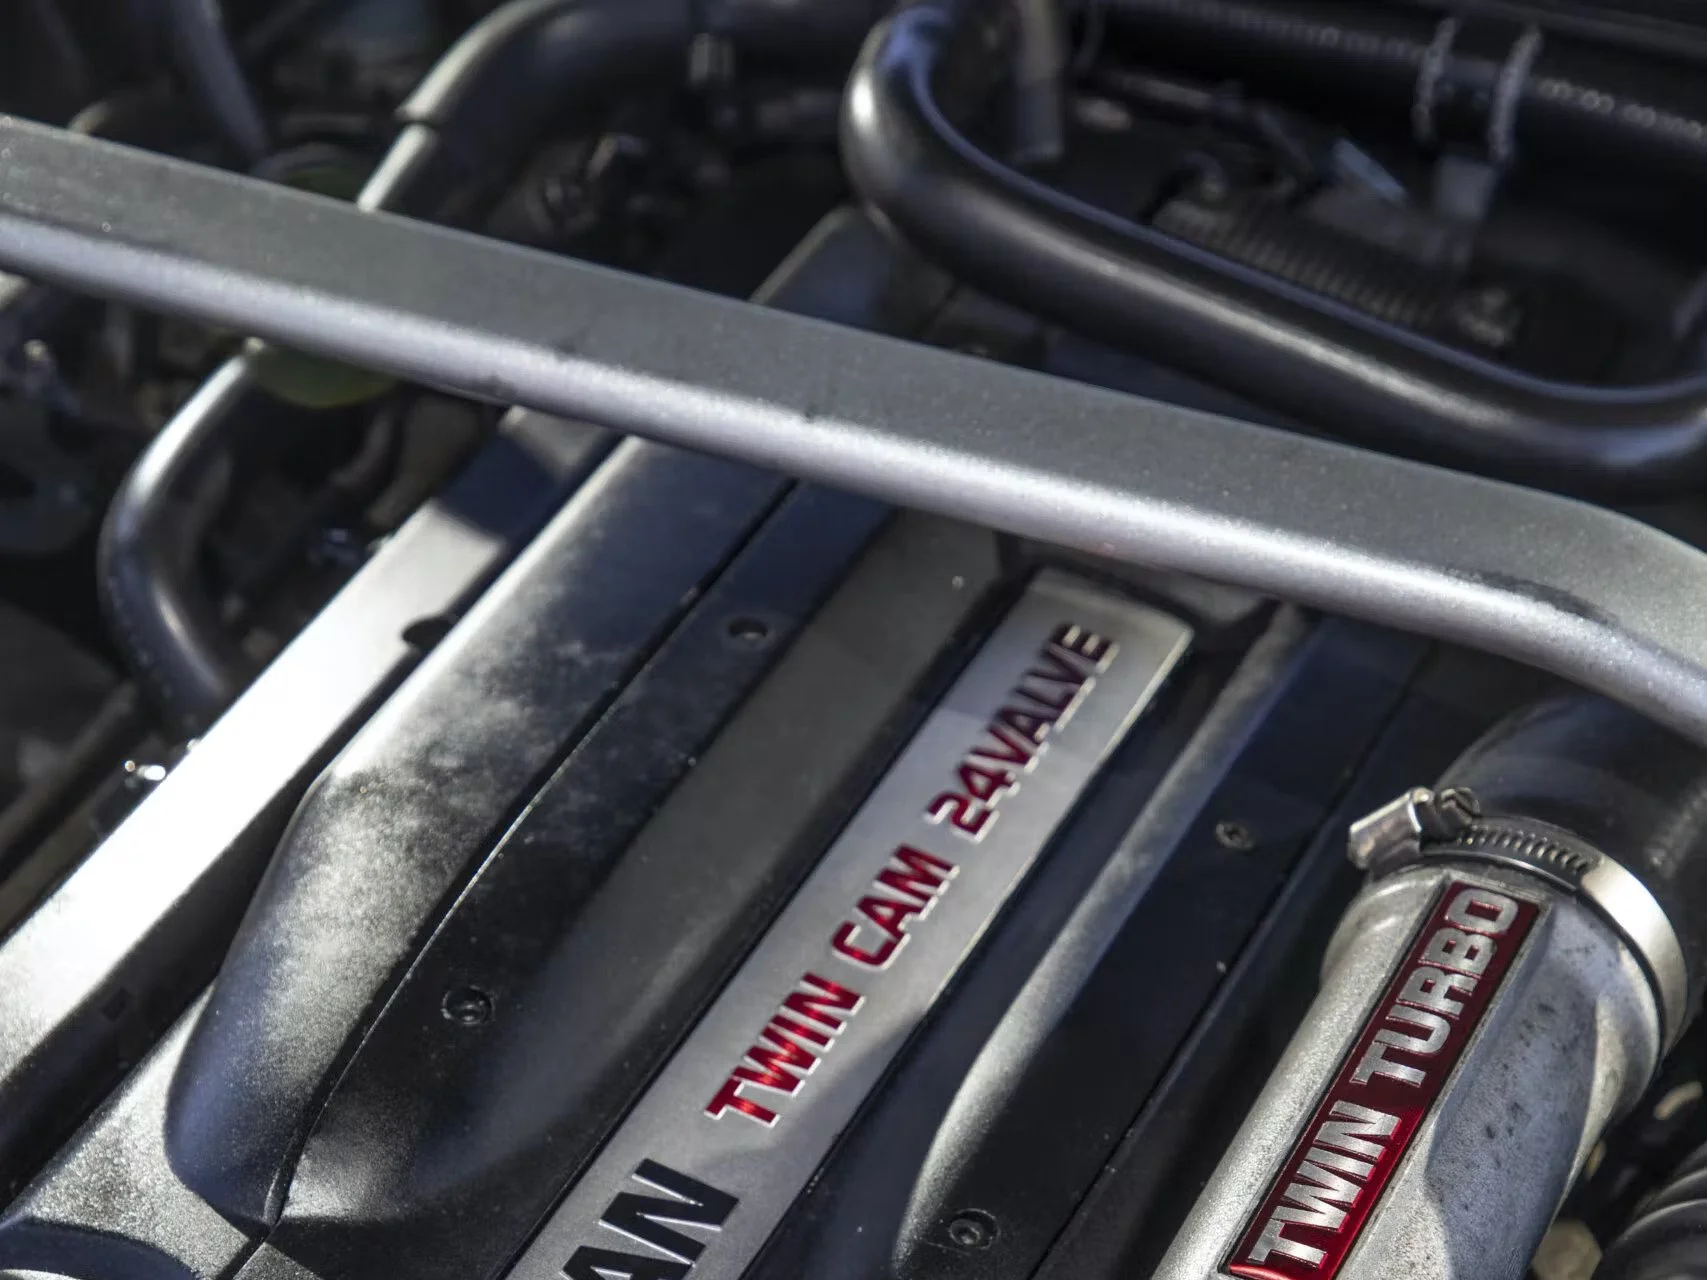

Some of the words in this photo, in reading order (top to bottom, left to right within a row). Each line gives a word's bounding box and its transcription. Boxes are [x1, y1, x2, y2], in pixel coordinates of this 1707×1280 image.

[705, 972, 866, 1128] TWIN
[831, 844, 960, 970] CAM
[923, 622, 1120, 843] 24VALVE
[1248, 1100, 1402, 1269] TWIN
[1349, 888, 1519, 1088] TURBO
